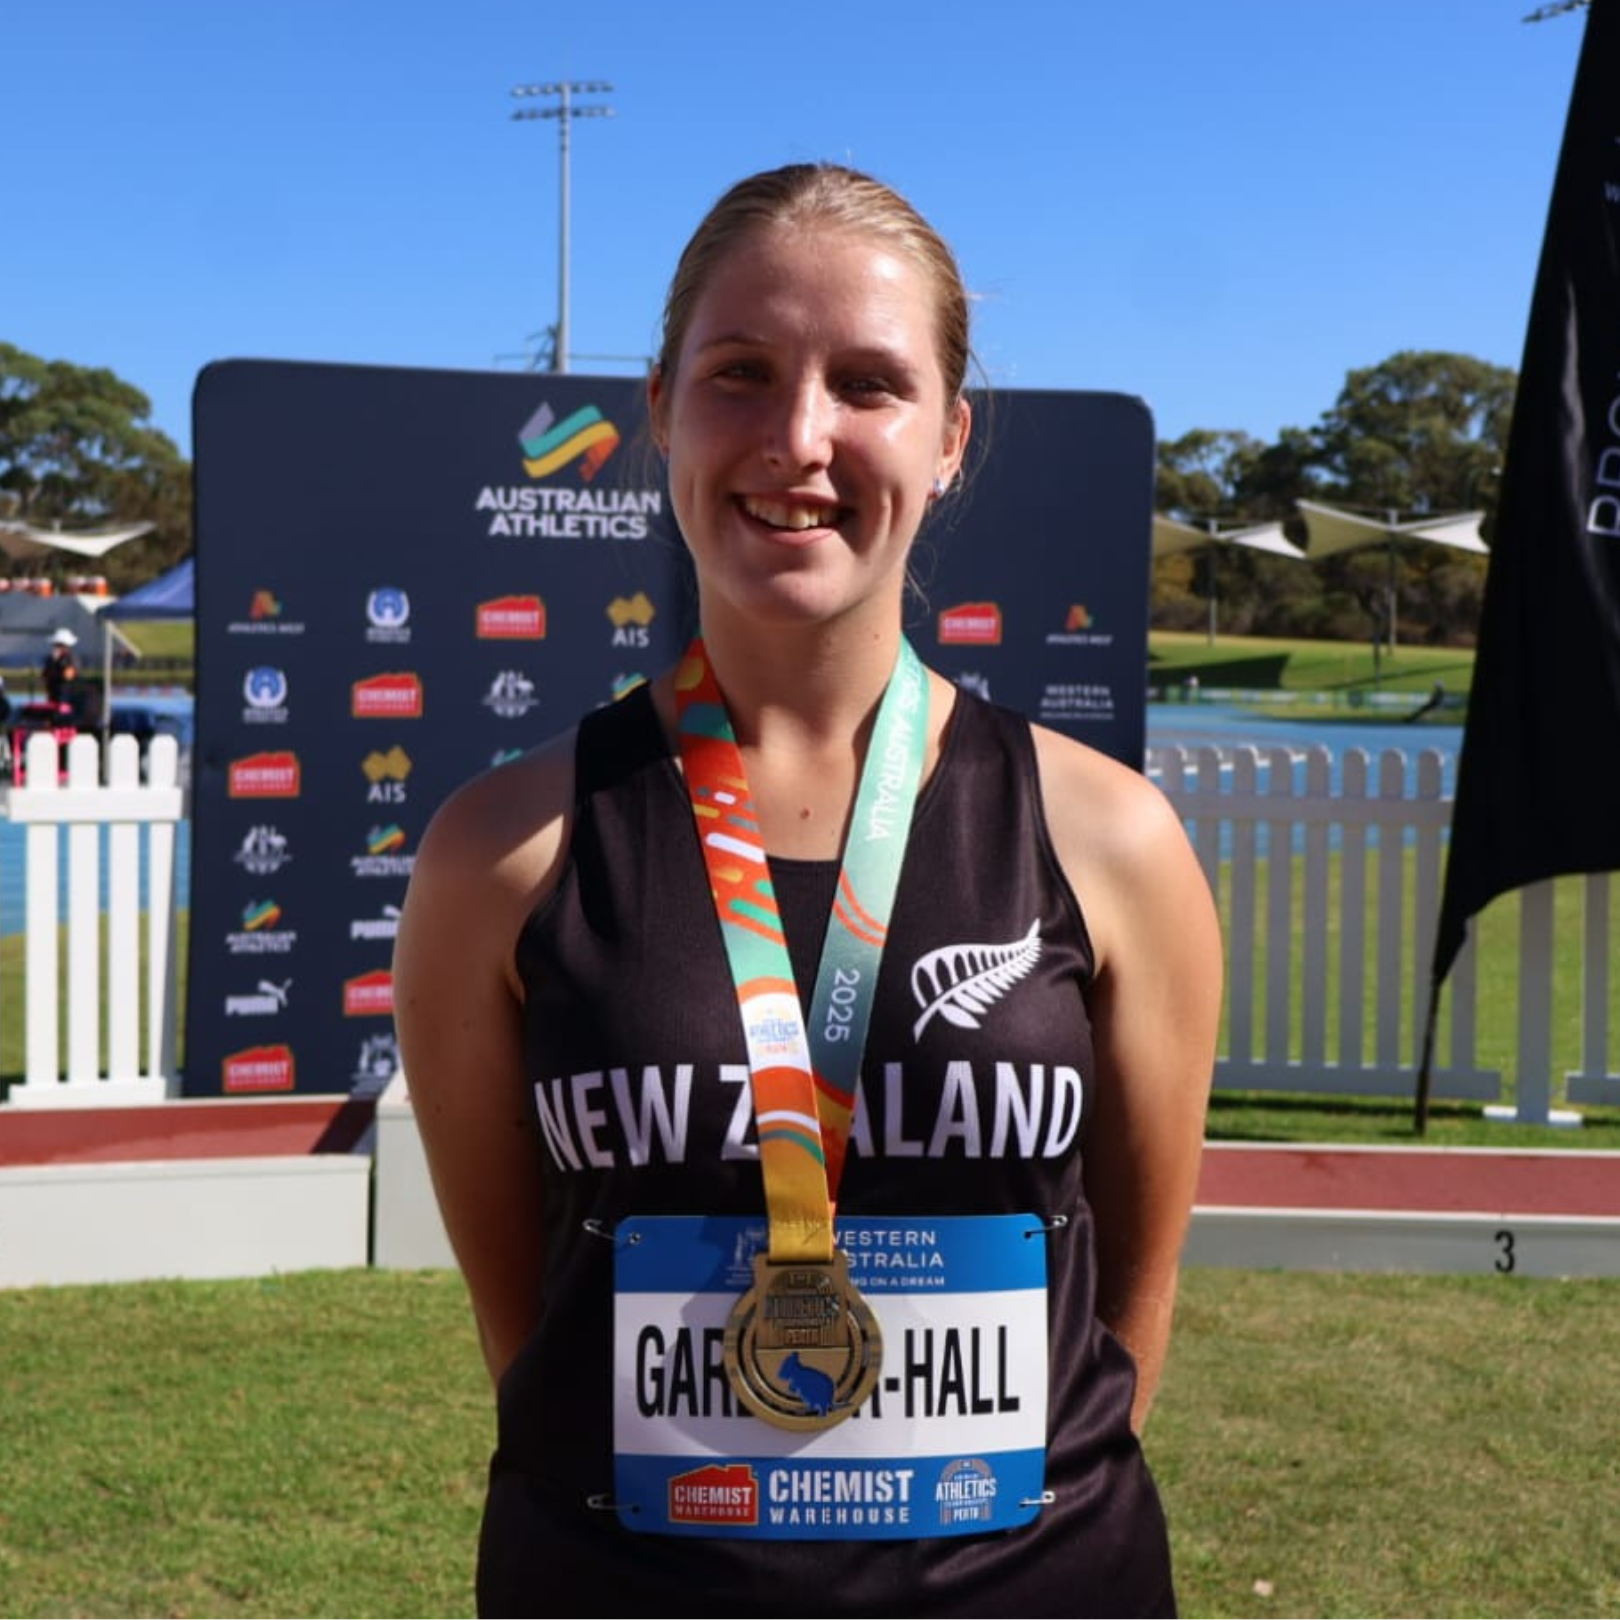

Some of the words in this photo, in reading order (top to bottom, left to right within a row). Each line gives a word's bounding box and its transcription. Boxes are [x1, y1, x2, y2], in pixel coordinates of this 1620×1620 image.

[476, 487, 661, 514] AUSTRALIAN
[489, 513, 648, 539] ATHLETICS
[612, 627, 649, 647] AIS
[866, 714, 914, 840] AUSTRALIA
[368, 783, 406, 803] AIS
[825, 968, 861, 1042] 2025
[534, 1064, 694, 1172] NEW
[719, 1061, 1082, 1160] ZLAND
[847, 1252, 944, 1268] STRALIA
[1495, 1230, 1515, 1273] 3
[636, 1325, 1020, 1419] GAR-HALL
[674, 1486, 752, 1505] CHEMIST
[769, 1470, 914, 1503] CHEMIST
[935, 1477, 997, 1502] ATHLETICS
[674, 1505, 750, 1518] WAREHOUSE
[769, 1506, 910, 1524] WAREHOUSE
